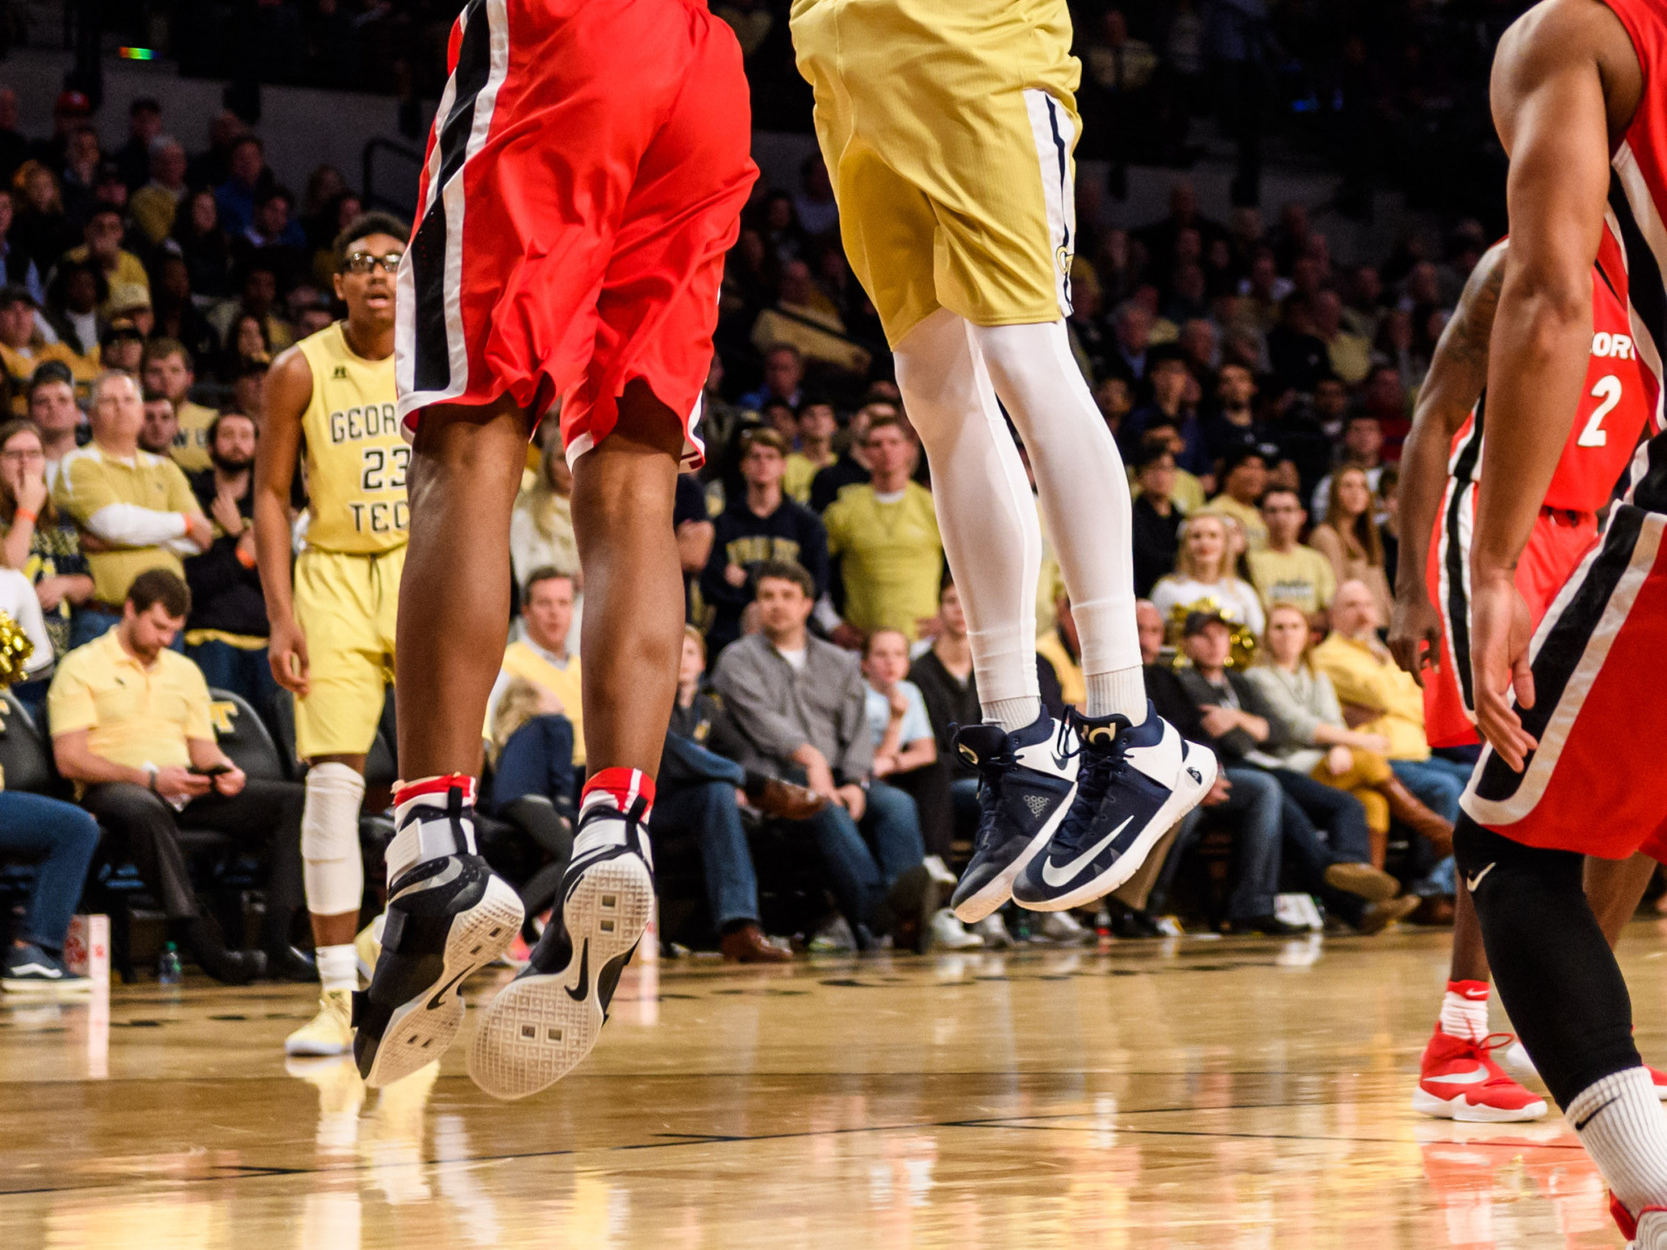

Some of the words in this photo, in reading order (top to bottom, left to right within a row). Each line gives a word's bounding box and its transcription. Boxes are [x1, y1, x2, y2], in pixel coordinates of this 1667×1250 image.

[1590, 331, 1636, 361] OR
[330, 403, 398, 444] GEOR
[1577, 374, 1622, 447] 2
[363, 447, 411, 491] 23
[349, 502, 410, 533] TEC
